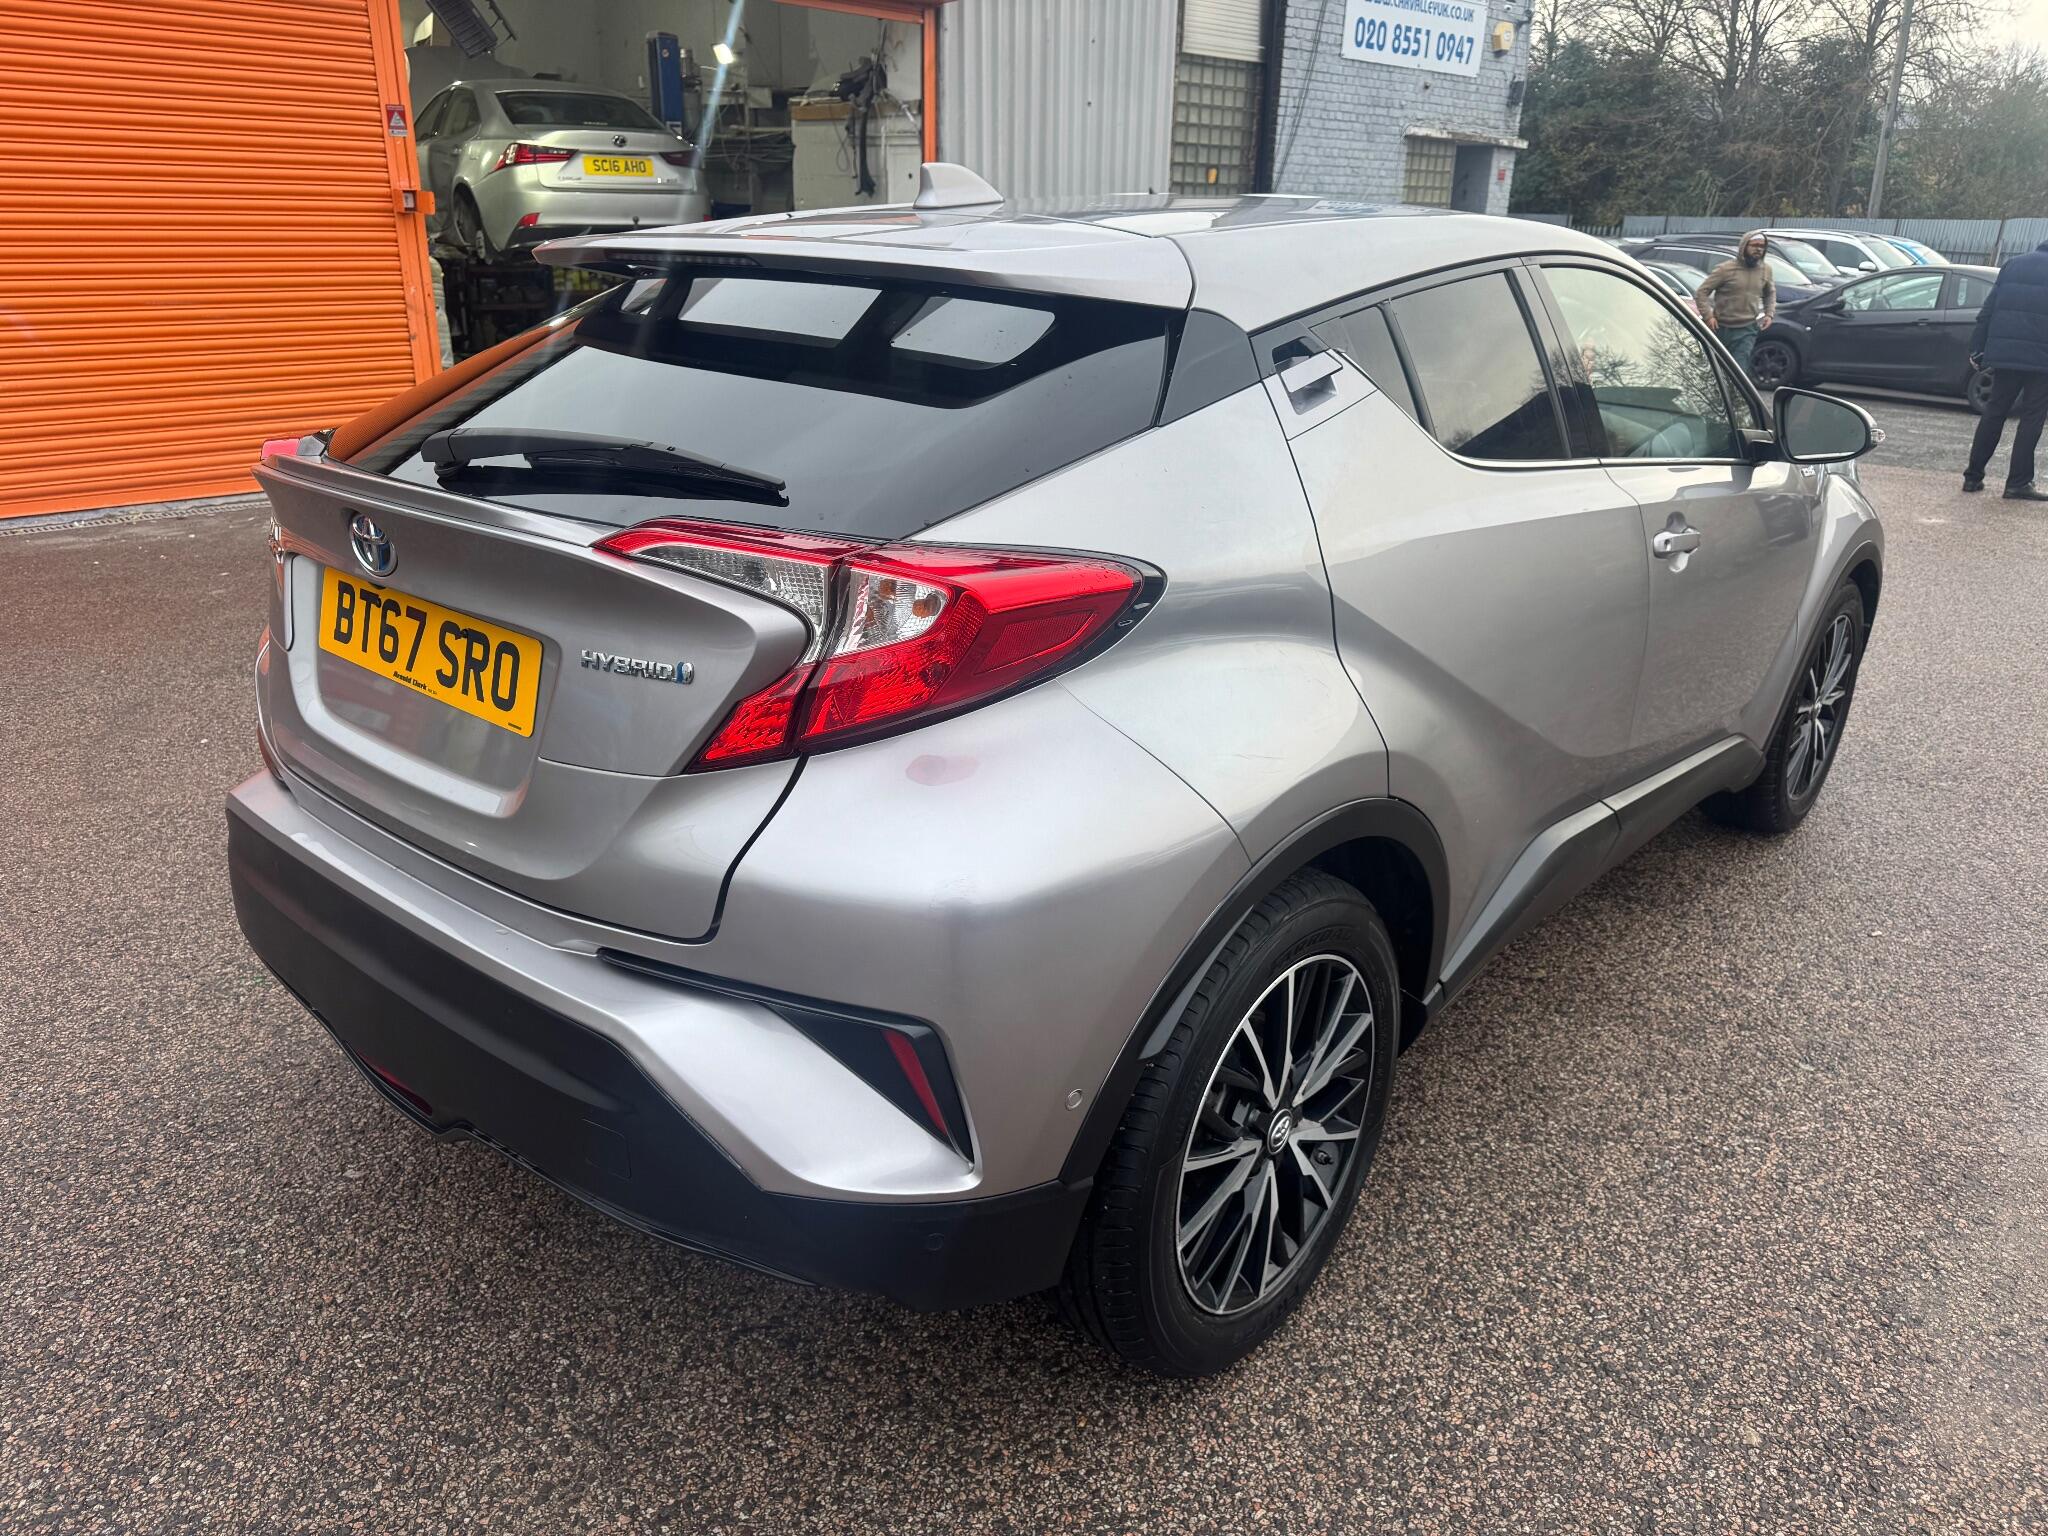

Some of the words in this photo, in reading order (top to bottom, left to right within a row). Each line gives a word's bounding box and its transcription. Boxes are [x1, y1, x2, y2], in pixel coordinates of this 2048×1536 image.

[1355, 16, 1387, 51] 020
[1392, 23, 1431, 58] 8551
[1436, 32, 1474, 64] 0947
[592, 159, 620, 172] SC16
[624, 161, 647, 173] AHO
[333, 579, 428, 672] BT67
[436, 620, 520, 712] SRO
[581, 649, 676, 682] HYBRID
